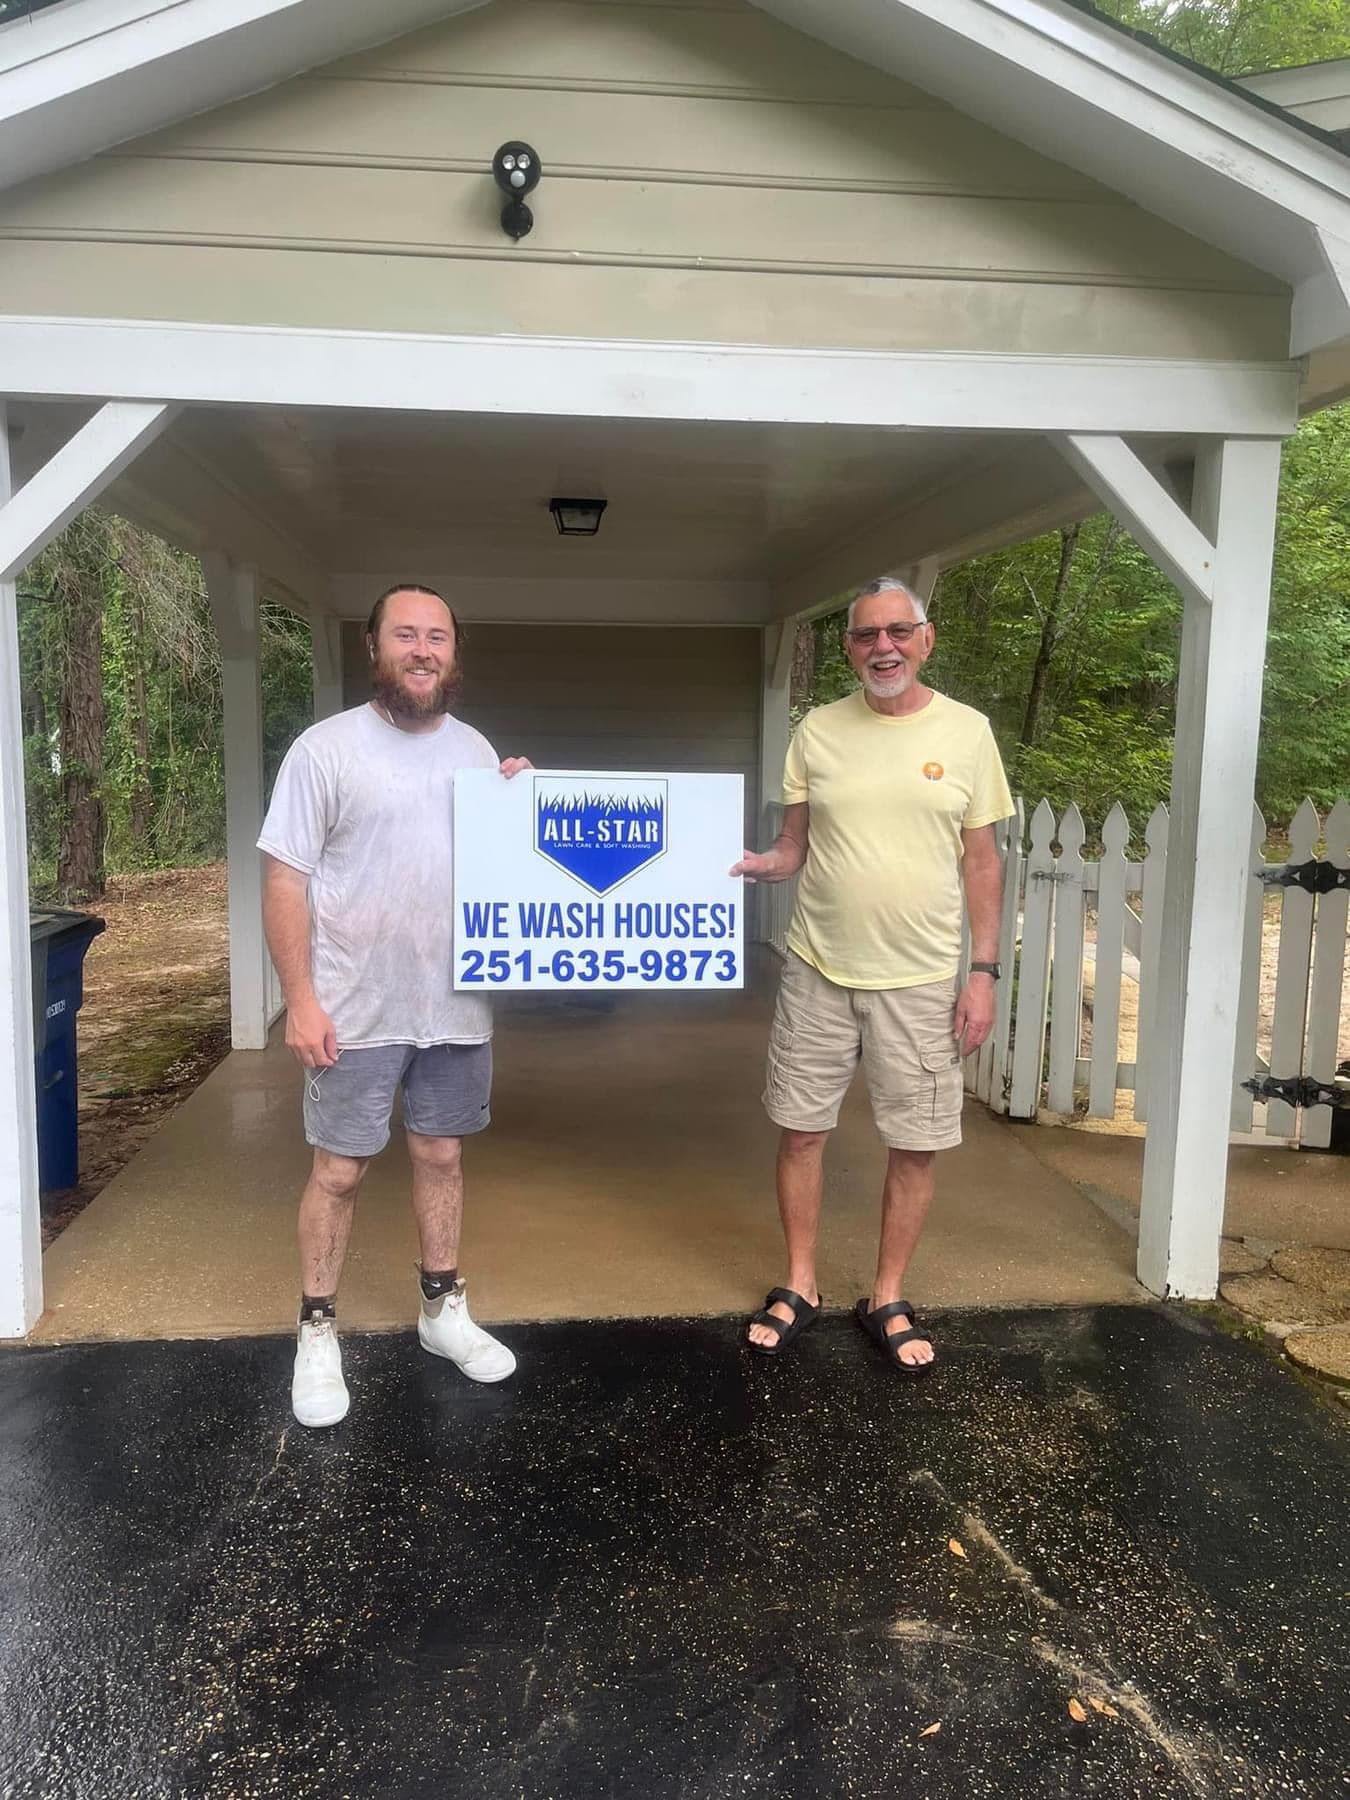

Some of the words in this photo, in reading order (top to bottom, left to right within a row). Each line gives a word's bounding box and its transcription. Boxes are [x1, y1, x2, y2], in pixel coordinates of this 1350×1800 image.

[543, 818, 658, 842] ALL-STAR
[463, 902, 509, 938] WE
[518, 902, 604, 938] WASH
[614, 903, 735, 939] HOUSES!
[460, 949, 737, 983] 251-635-9873
